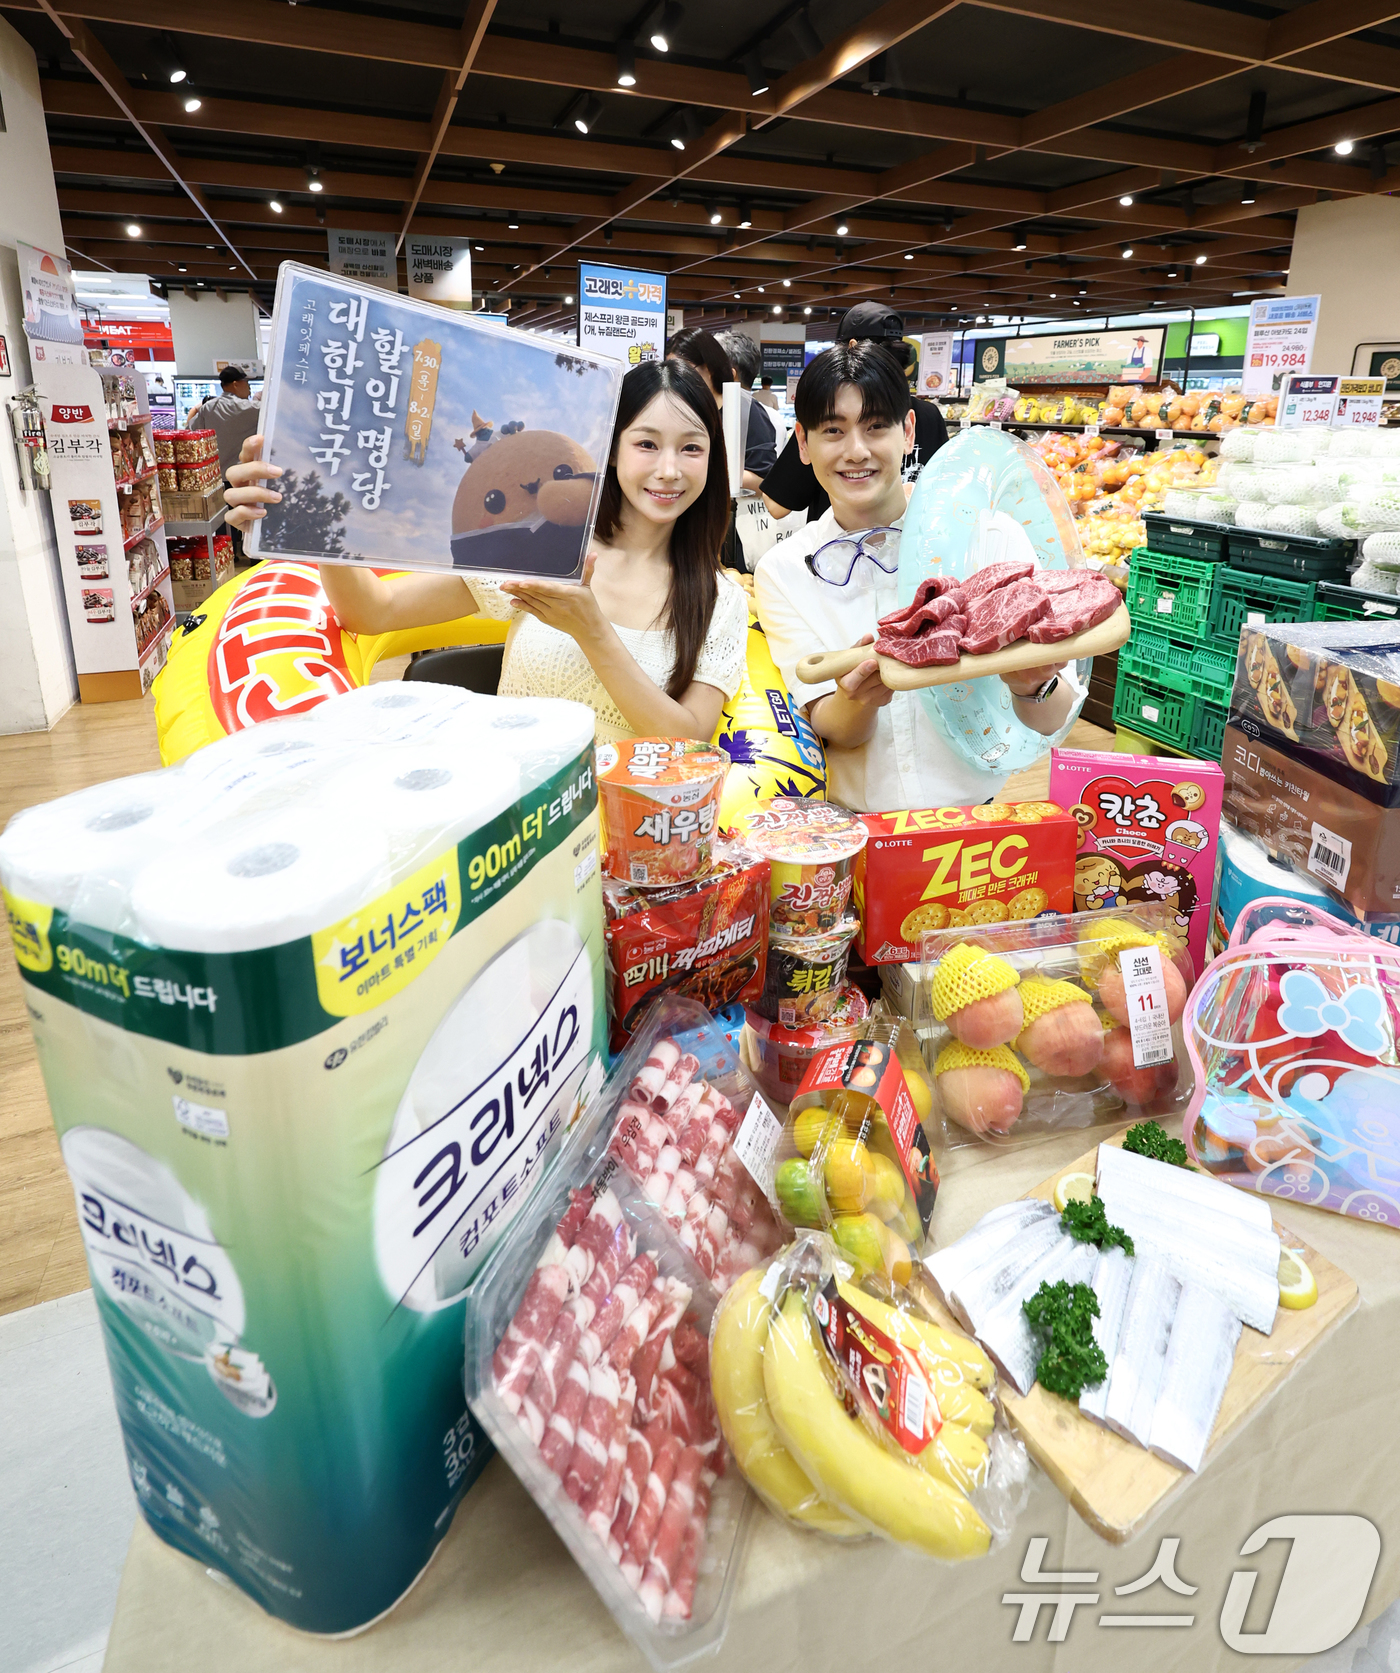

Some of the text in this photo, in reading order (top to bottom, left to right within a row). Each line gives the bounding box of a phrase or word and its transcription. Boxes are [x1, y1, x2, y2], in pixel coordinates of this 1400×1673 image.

[371, 248, 387, 258] 바로
[411, 244, 453, 258] 도매시장
[412, 258, 454, 271] 새벽배송
[413, 272, 434, 284] 상품
[585, 276, 663, 304] 고래잇 가격
[584, 311, 658, 328] 제스프리 왕큰 골드키위
[98, 325, 133, 335] MEAT
[584, 325, 637, 339] (개, 뉴질랜드산)
[1254, 329, 1270, 337] 페루산
[1294, 327, 1308, 335] 24입
[294, 299, 317, 385] 고래잇페스타
[1053, 337, 1100, 349] FARMER'S PICK
[1265, 353, 1306, 367] 19,984
[308, 297, 369, 477] 대한민국
[58, 407, 84, 420] 양반
[1302, 409, 1330, 422] 12,348
[1352, 412, 1377, 423] 12,948
[50, 438, 103, 454] 김부각
[627, 741, 672, 779] 새우탕
[1234, 744, 1261, 773] 코디
[1066, 764, 1092, 773] LOTTE
[1259, 768, 1283, 787] 뽑아쓰는
[1285, 783, 1310, 802] 키친타월
[1099, 791, 1167, 829] 칸쵸
[634, 799, 718, 846] 새우탕
[744, 808, 838, 831] 진짬뽕
[881, 806, 966, 835] ZEC
[468, 834, 521, 891] 90m
[547, 766, 593, 826] 드립니다
[1115, 828, 1147, 837] Choco
[884, 839, 913, 848] LOTTE
[1147, 842, 1161, 852] 이야기
[919, 834, 1029, 902] ZEC
[957, 870, 1039, 904] 제대로 만든 크래커!
[338, 878, 448, 984] 보너스팩
[671, 914, 757, 970] 짜파게티
[356, 928, 438, 996] 이마트 특별 기획
[1133, 956, 1149, 967] 신선
[56, 944, 109, 985] 90m
[133, 976, 218, 1013] 드립니다
[1133, 966, 1153, 977] 그대로
[1138, 993, 1154, 1012] 11
[1152, 1013, 1165, 1021] 국내산
[1134, 1020, 1166, 1032] 부드러운 복숭아
[412, 1004, 580, 1239] 크리넥스
[591, 1156, 619, 1203] 차돌박이
[621, 1115, 642, 1147] 우삼겹
[81, 1193, 222, 1301] 크리넥스
